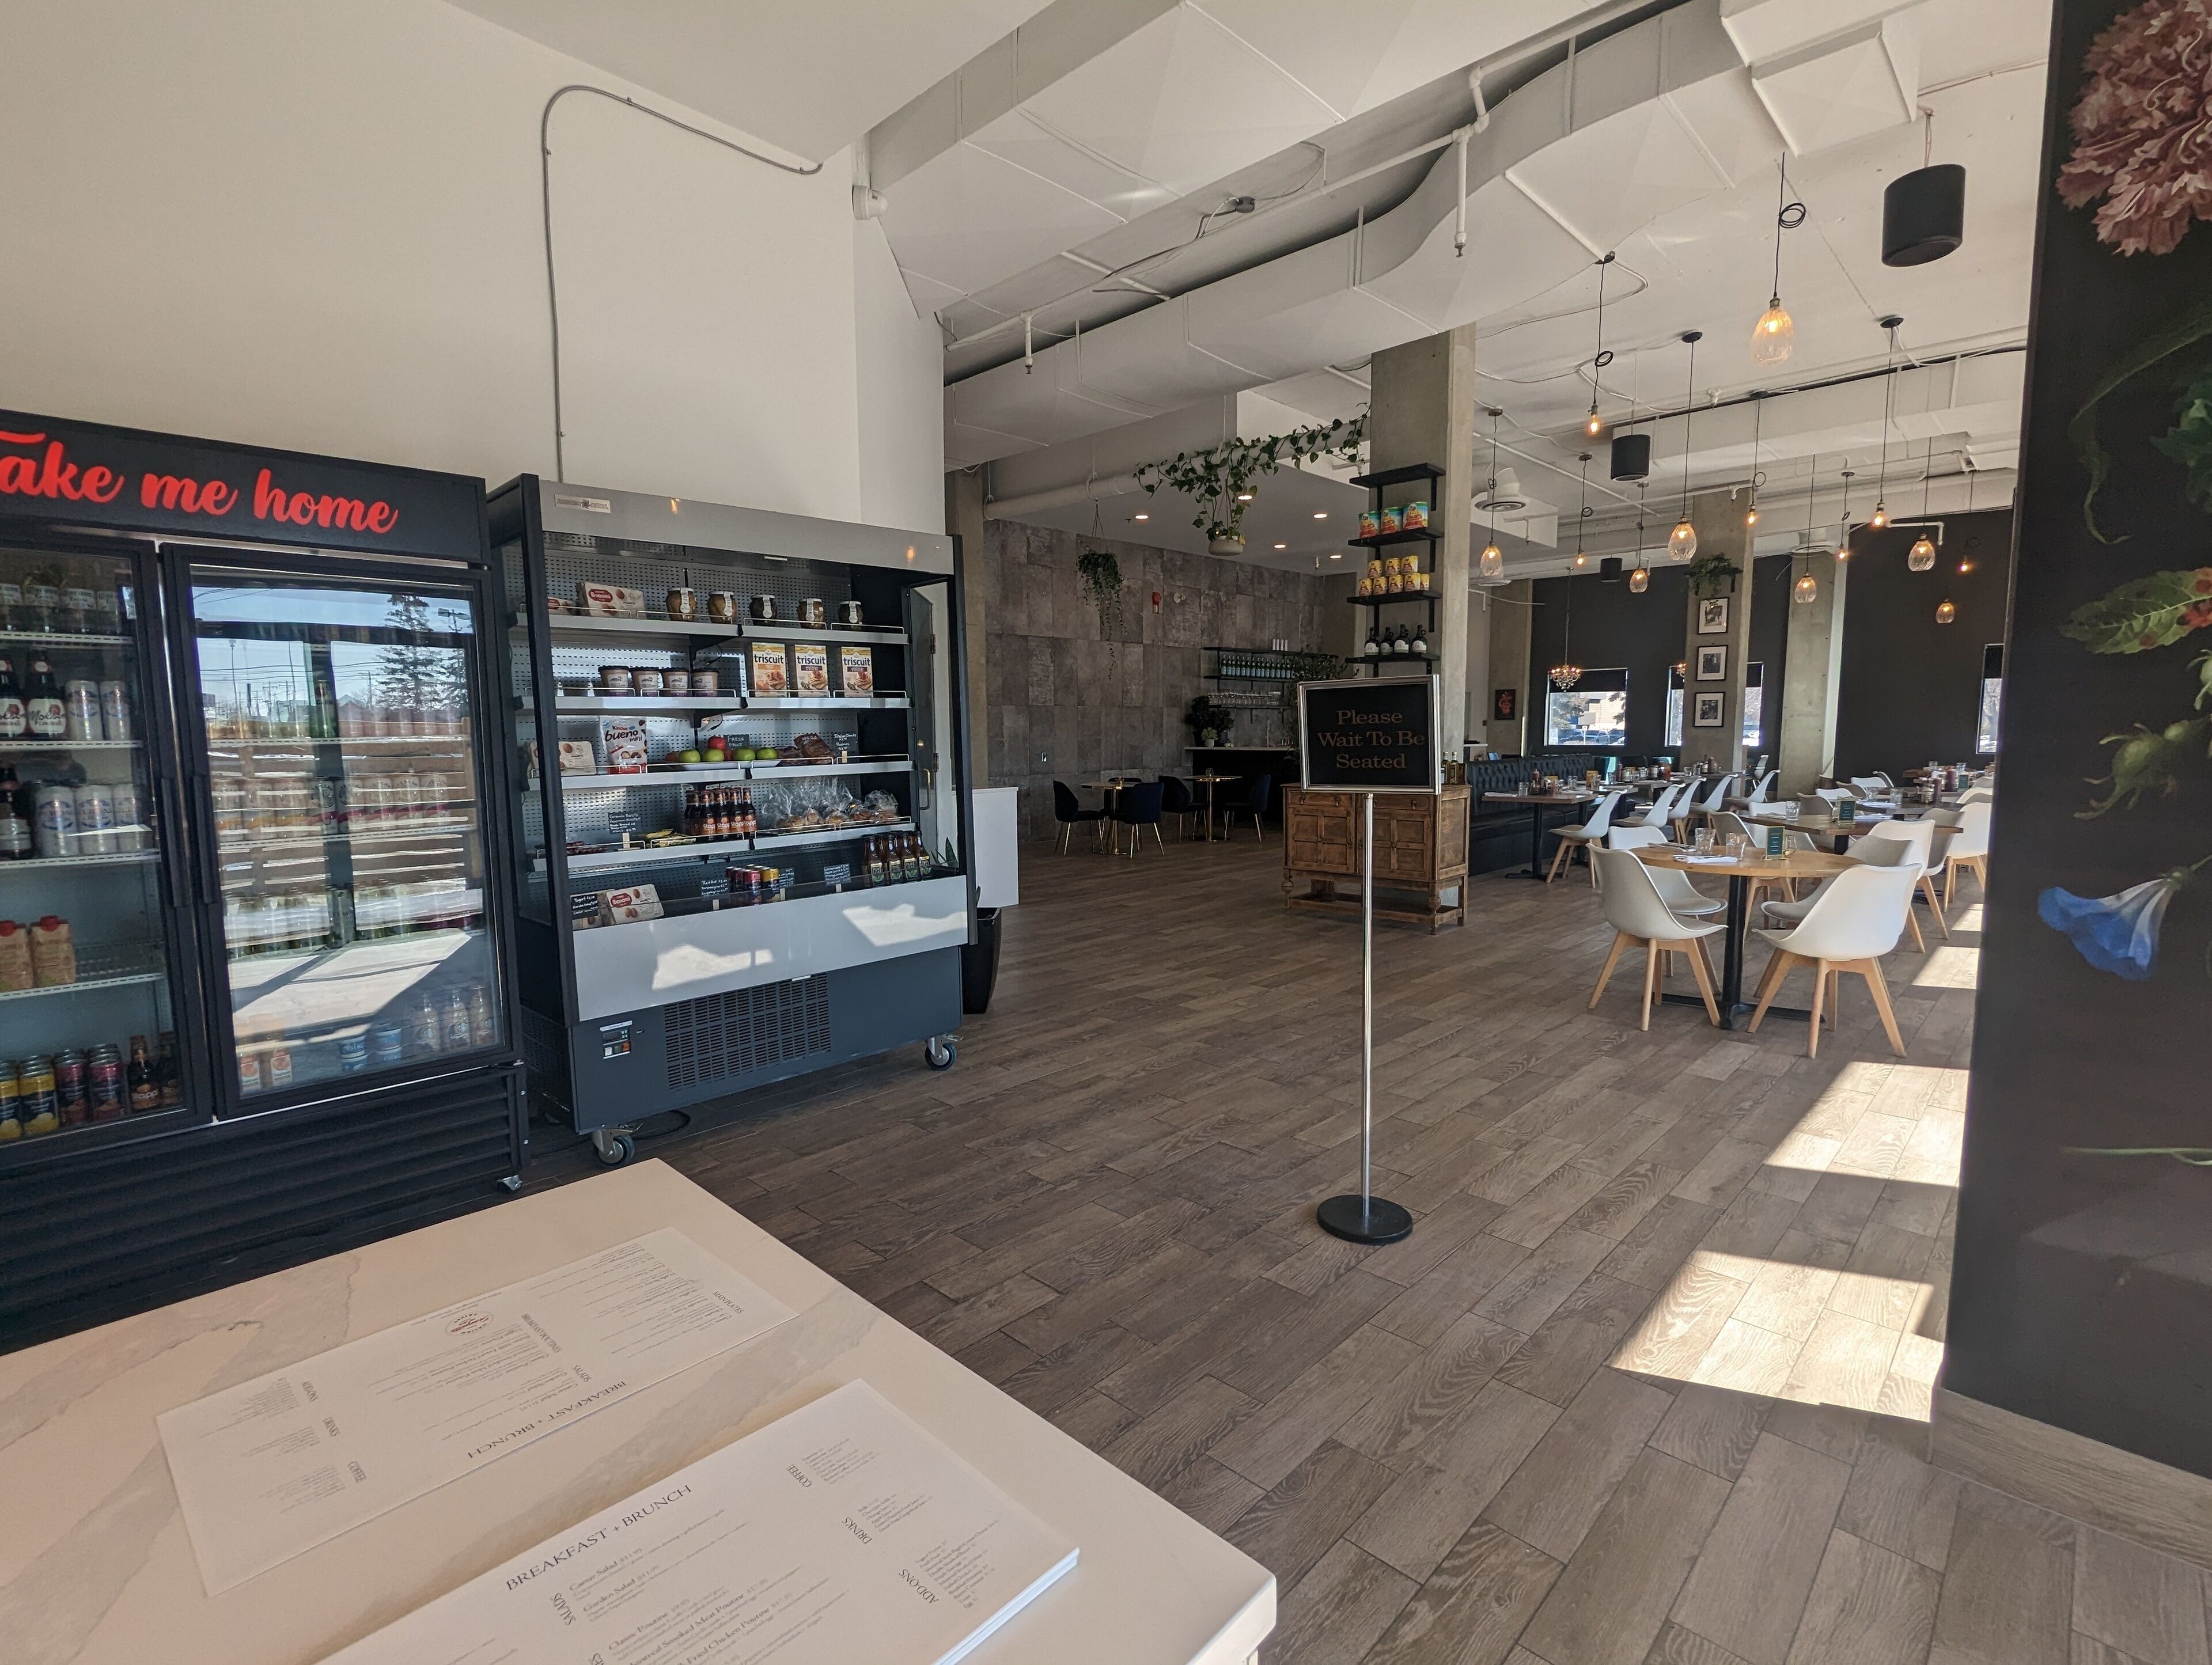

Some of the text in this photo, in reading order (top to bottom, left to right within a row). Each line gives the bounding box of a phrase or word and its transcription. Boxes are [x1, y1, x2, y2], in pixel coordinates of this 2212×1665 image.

[141, 472, 238, 516] me
[253, 468, 399, 533] home
[754, 654, 784, 664] triscuit
[797, 655, 825, 665] triscuit
[843, 657, 870, 666] triscuit
[1336, 710, 1403, 725] Please
[605, 729, 638, 741] bueno
[1317, 731, 1425, 747] Wait To Be
[1336, 754, 1407, 769] Seated
[612, 896, 630, 905] Bonomi
[548, 1380, 627, 1420] BREAKFAST
[468, 1423, 535, 1459] BRUNCH
[786, 1463, 812, 1488] COFFEE
[507, 1527, 607, 1591] BREAKFAST
[622, 1484, 692, 1528] BRUNCH
[842, 1516, 873, 1545] DRINKS
[596, 1560, 618, 1576] Salad
[550, 1592, 577, 1626] SALADS
[740, 1607, 770, 1629] Poutine
[662, 1623, 695, 1647] Smoked
[715, 1594, 745, 1614] Poutine
